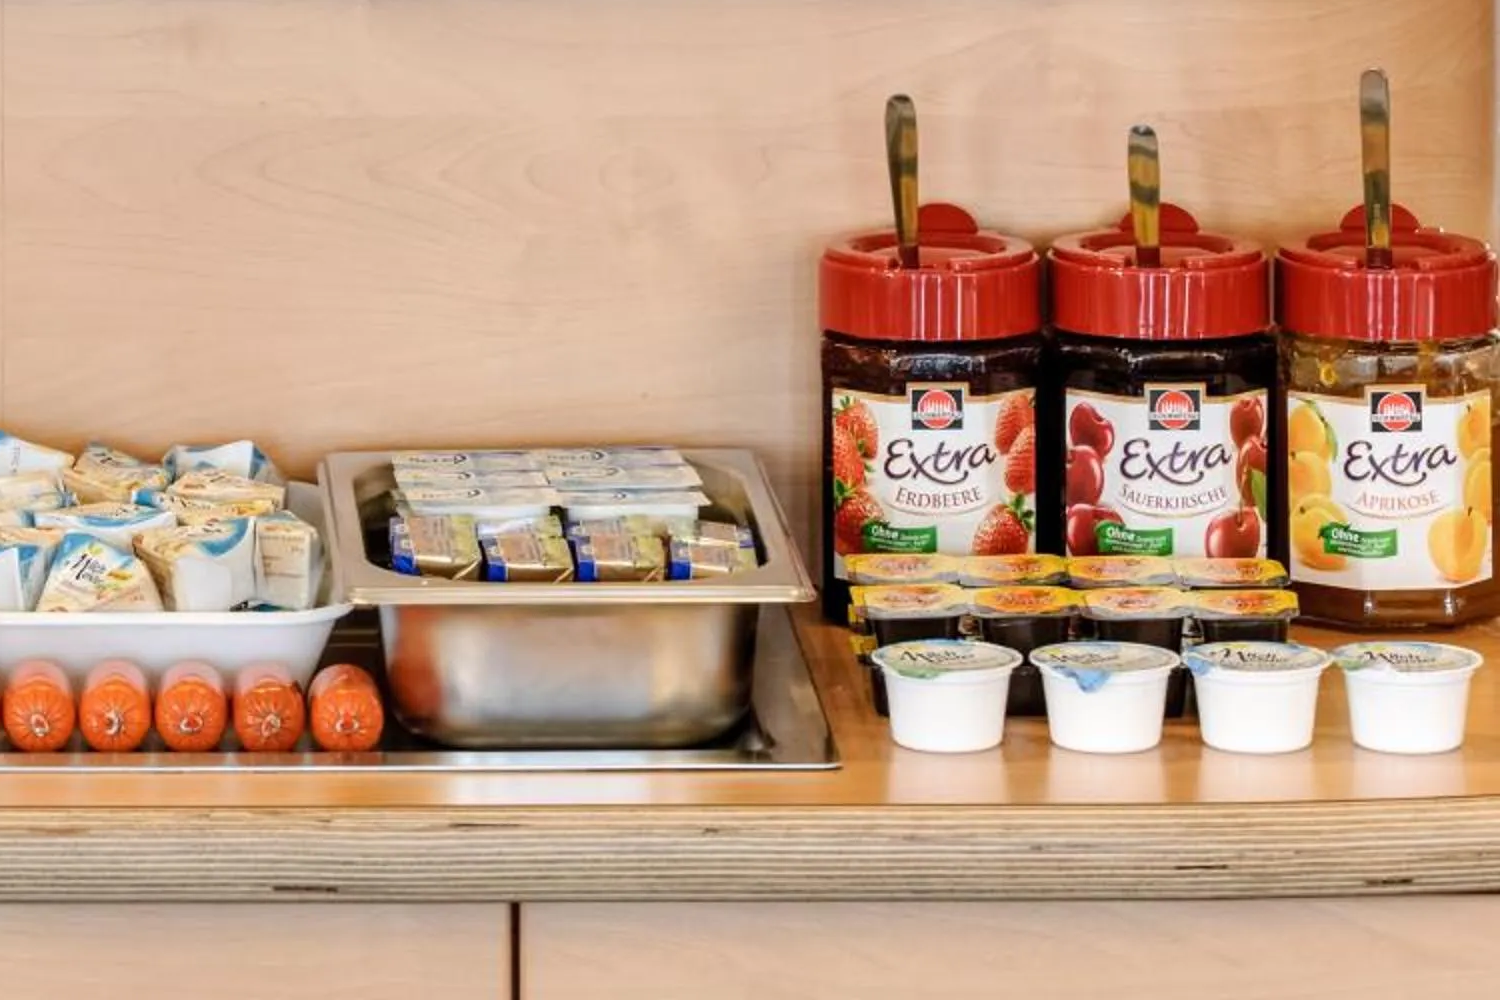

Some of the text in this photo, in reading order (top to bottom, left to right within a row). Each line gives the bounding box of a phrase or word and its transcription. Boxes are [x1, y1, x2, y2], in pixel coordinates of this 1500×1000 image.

[884, 438, 997, 484] Extra
[1120, 438, 1232, 486] Extra
[1343, 440, 1457, 486] Extra
[894, 487, 984, 509] ERDBEERE
[1119, 484, 1228, 510] SAUERKIRSCHE
[1357, 492, 1441, 511] APRIKOSE
